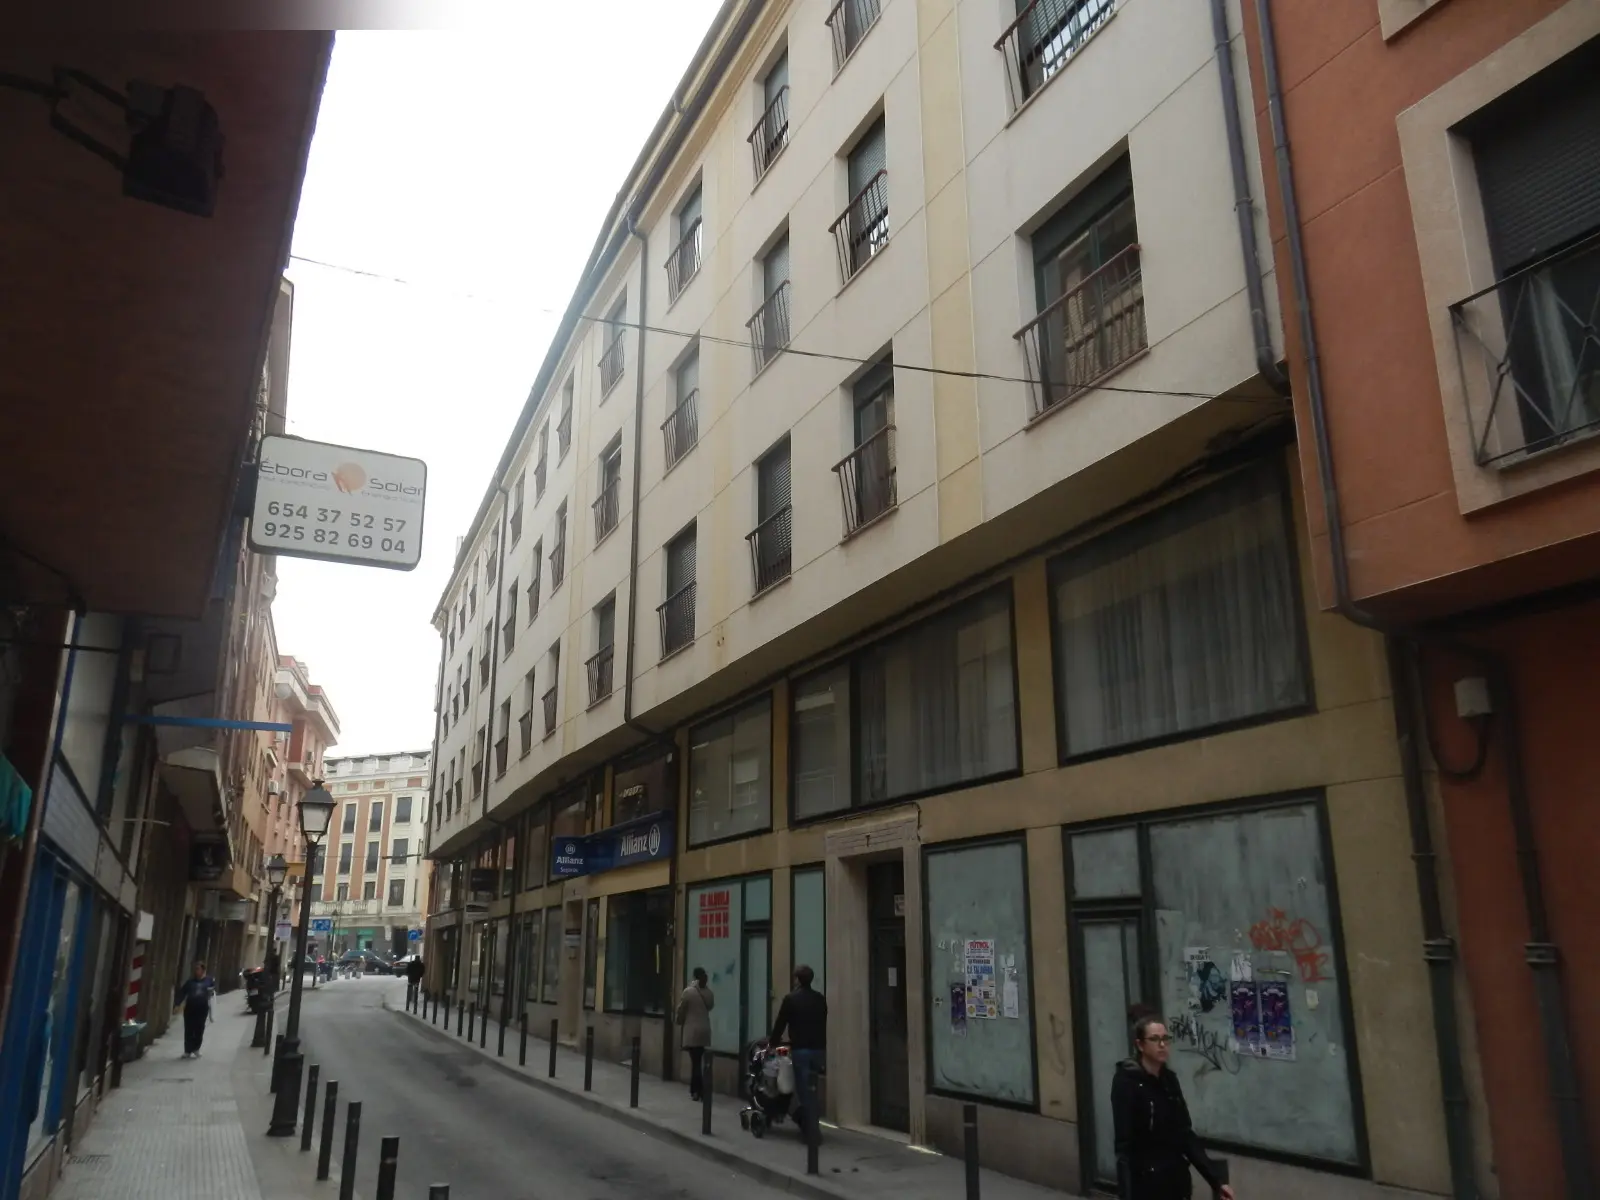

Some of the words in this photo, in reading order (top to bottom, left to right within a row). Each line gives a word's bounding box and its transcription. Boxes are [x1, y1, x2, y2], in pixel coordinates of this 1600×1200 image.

[370, 477, 423, 497] Solar
[268, 501, 308, 519] 654
[317, 507, 341, 524] 37
[350, 513, 375, 529] 52
[383, 517, 407, 533] 57
[264, 522, 305, 541] 925
[313, 529, 339, 546] 82
[348, 533, 373, 550] 69
[380, 538, 406, 554] 04
[620, 834, 648, 857] Allianz
[556, 855, 584, 865] Allianz
